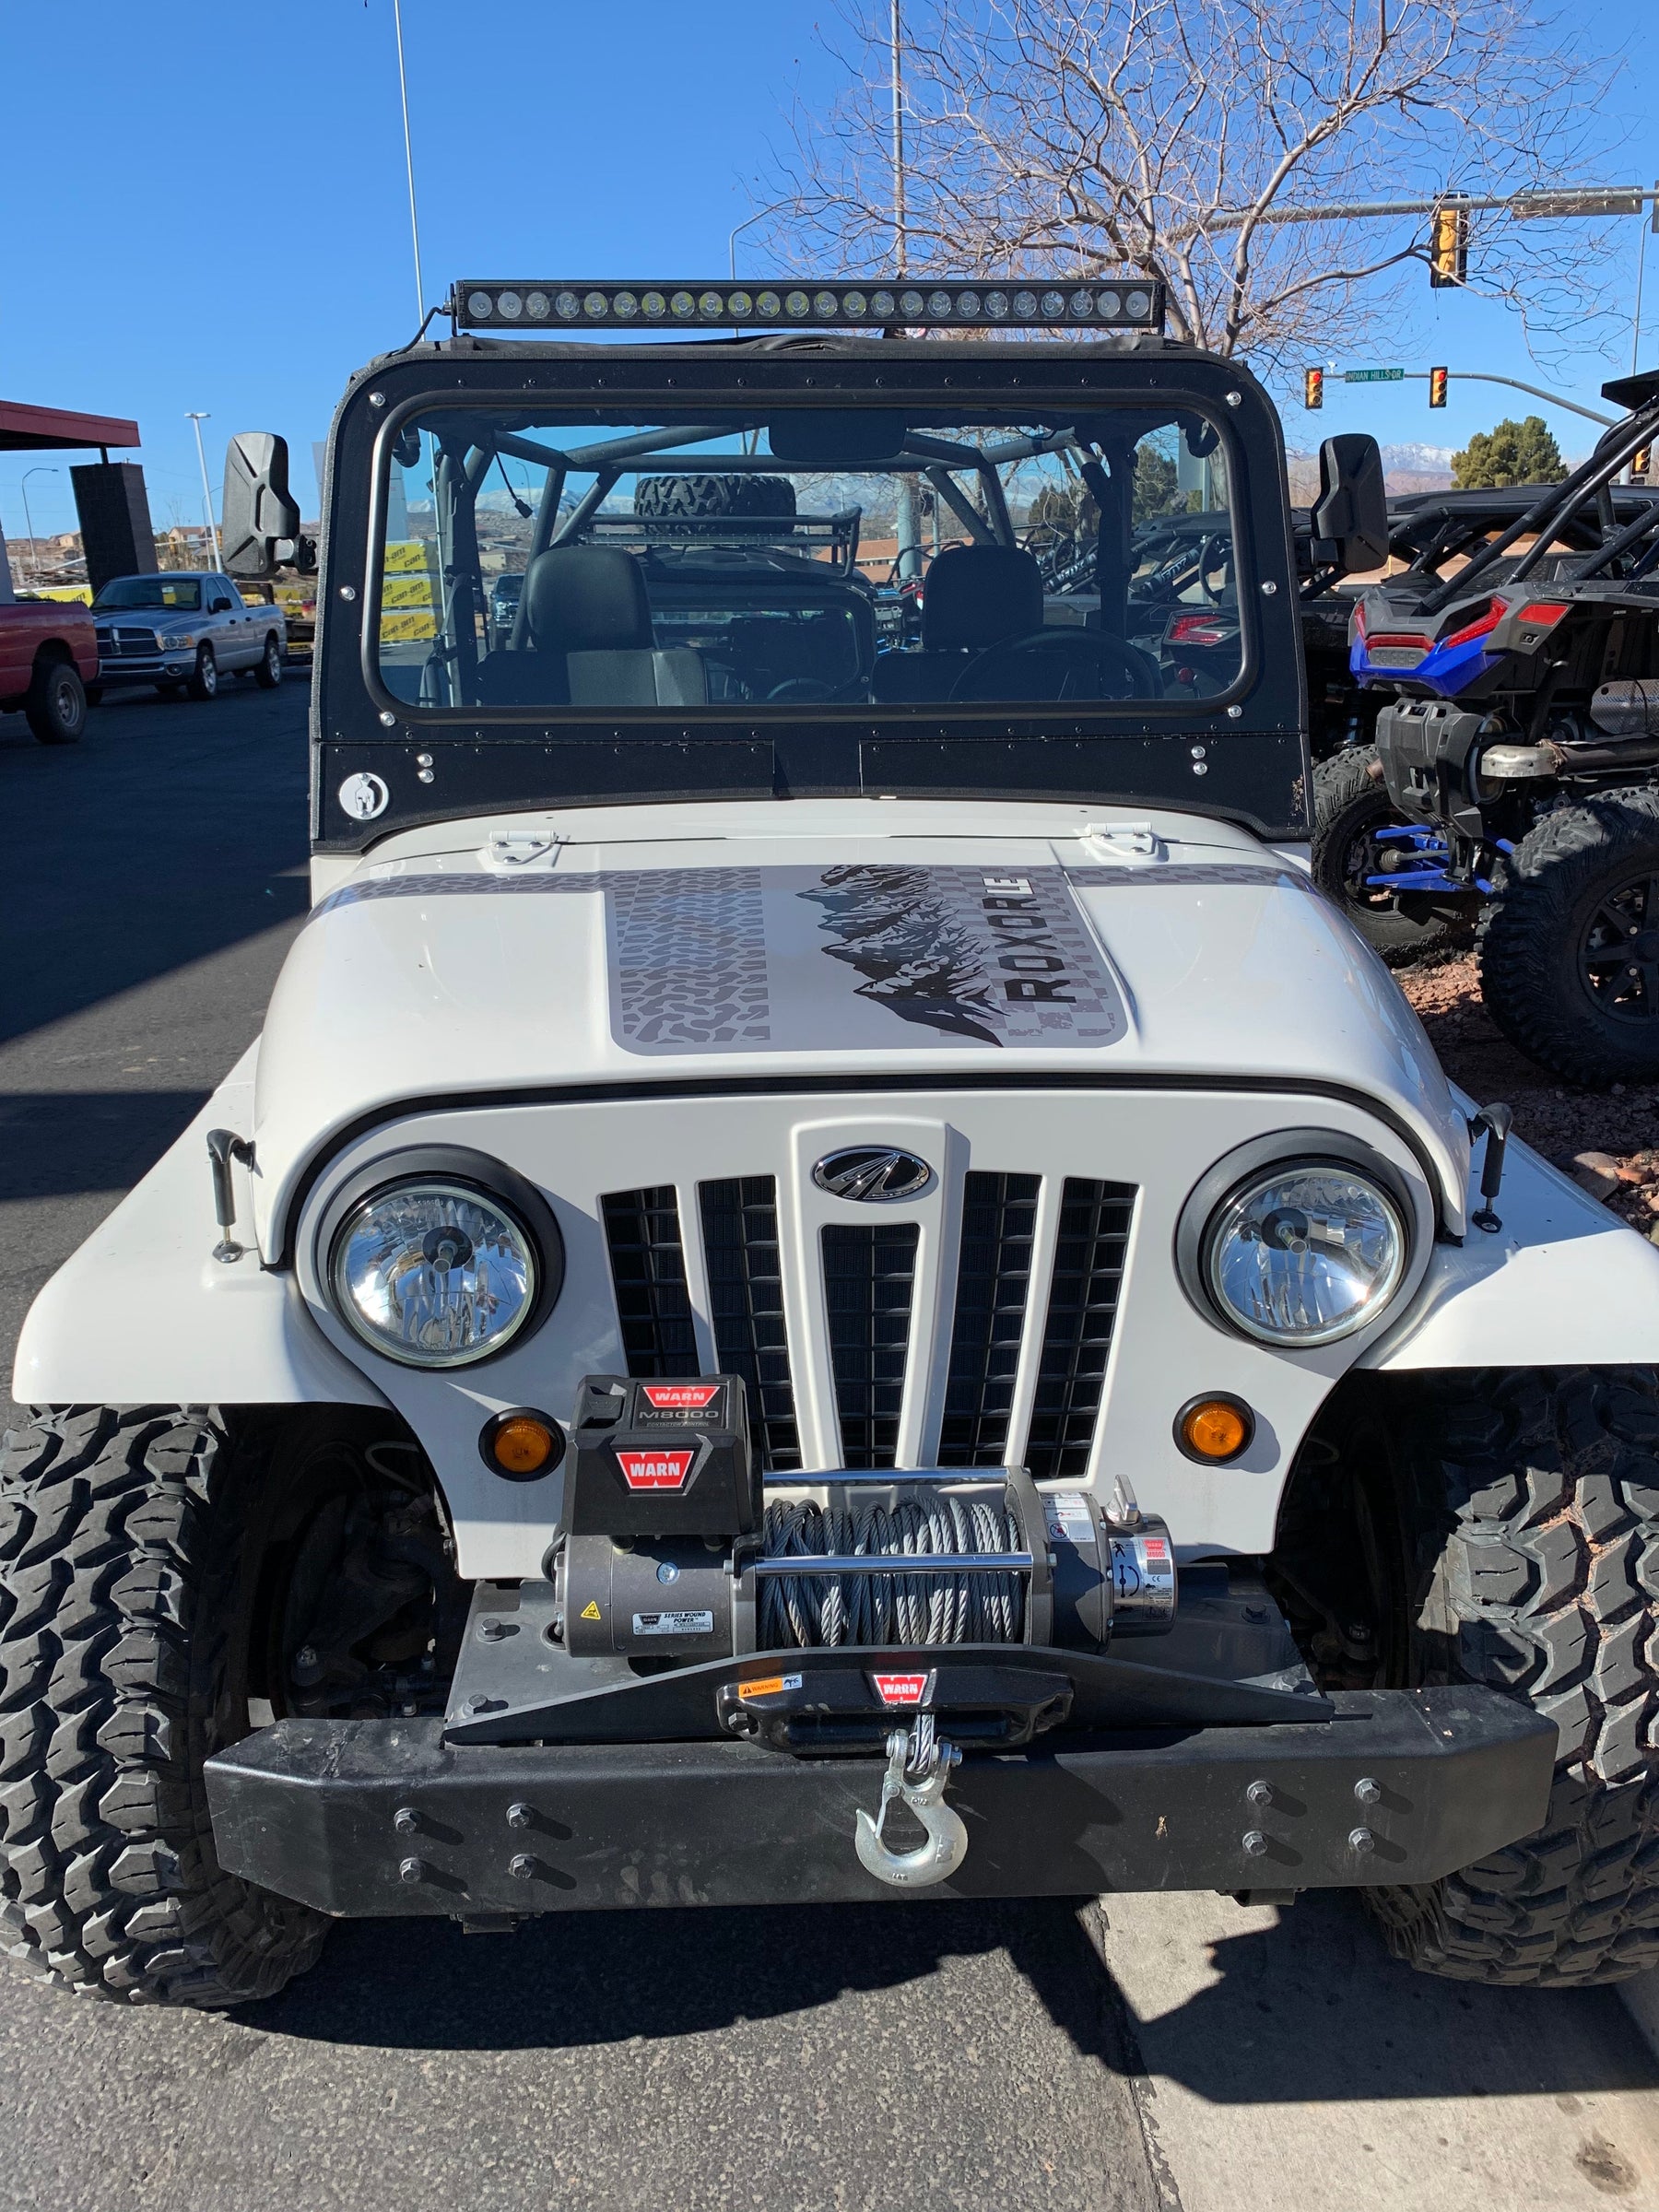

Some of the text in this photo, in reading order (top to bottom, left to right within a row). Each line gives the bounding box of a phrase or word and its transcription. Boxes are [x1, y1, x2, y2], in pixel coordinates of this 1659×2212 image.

[1347, 371, 1369, 382] INDIAN
[1371, 370, 1390, 380] HILLS
[982, 897, 1077, 1004] ROXOR
[654, 1392, 705, 1401] WARN
[639, 1410, 719, 1419] M8000
[629, 1463, 680, 1477] WARN
[751, 1682, 779, 1691] WARNING
[883, 1683, 919, 1694] WARN
